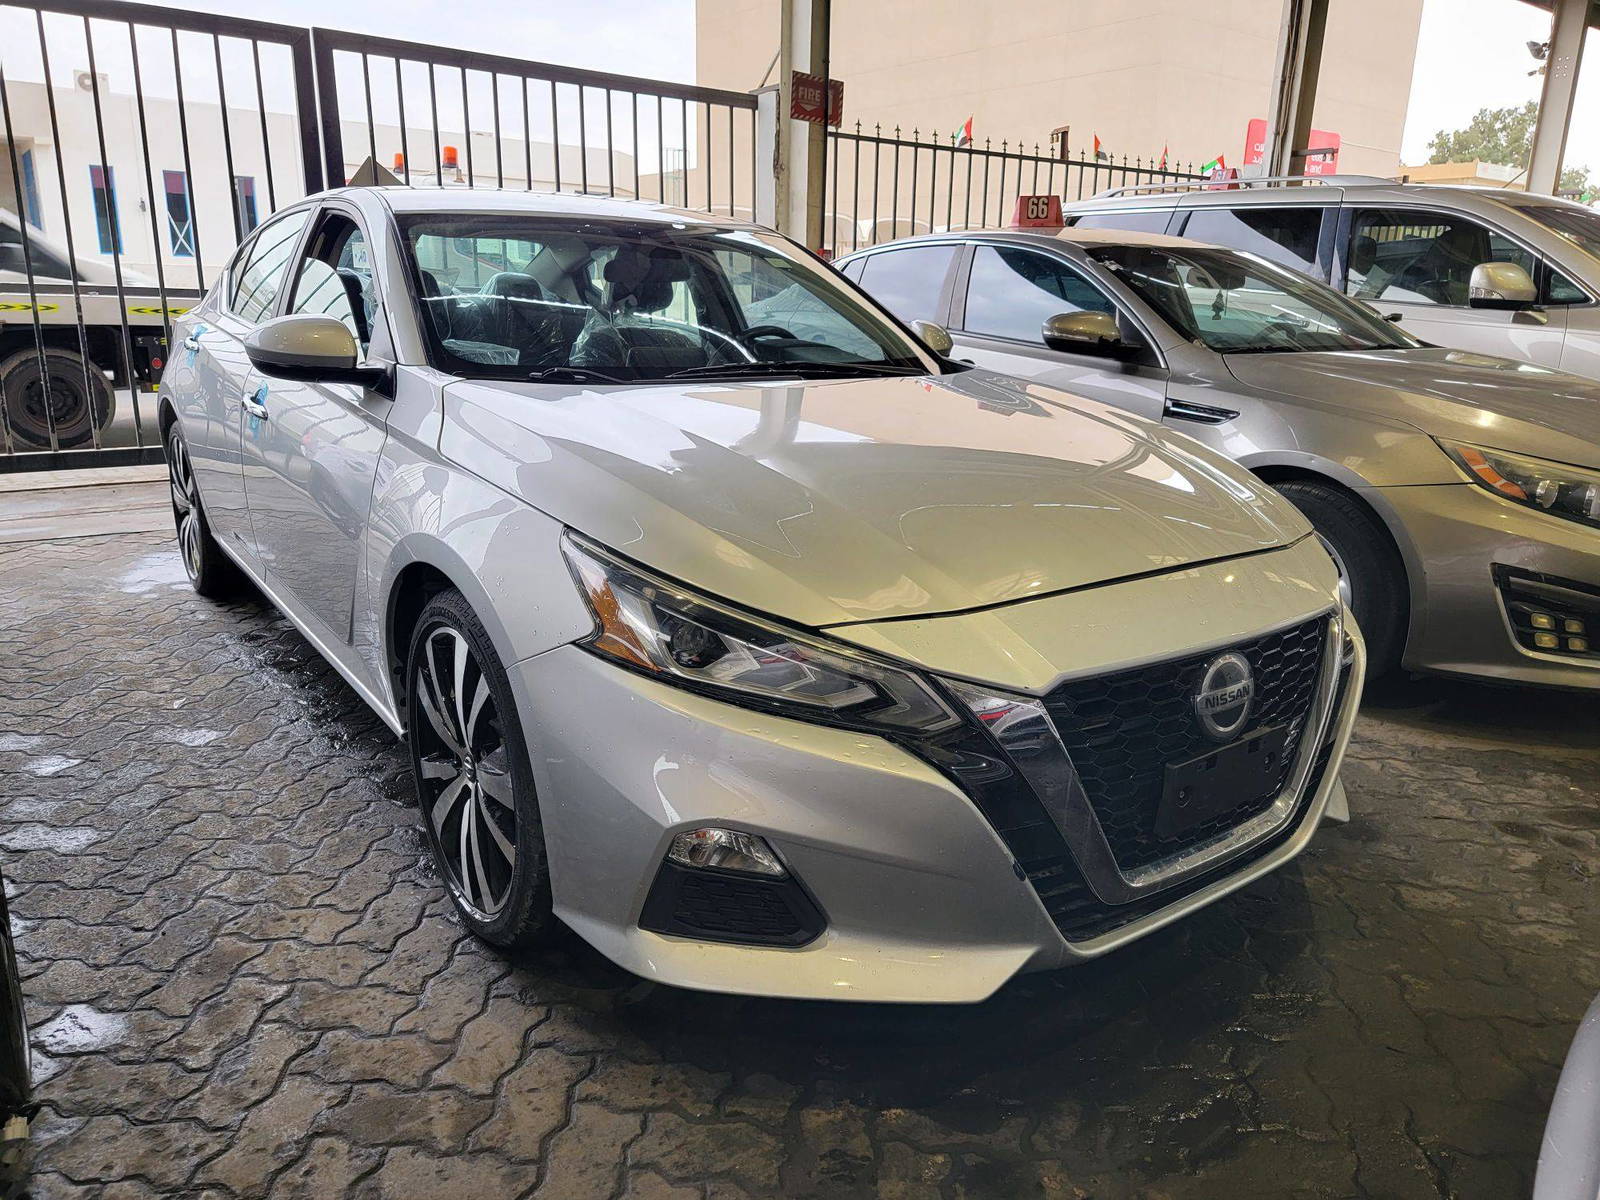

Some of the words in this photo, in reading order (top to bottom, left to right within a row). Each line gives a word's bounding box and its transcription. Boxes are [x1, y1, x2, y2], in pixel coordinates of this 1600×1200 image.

[798, 86, 821, 102] FIRE
[1027, 197, 1048, 219] 66
[1204, 685, 1250, 709] NISSAN
